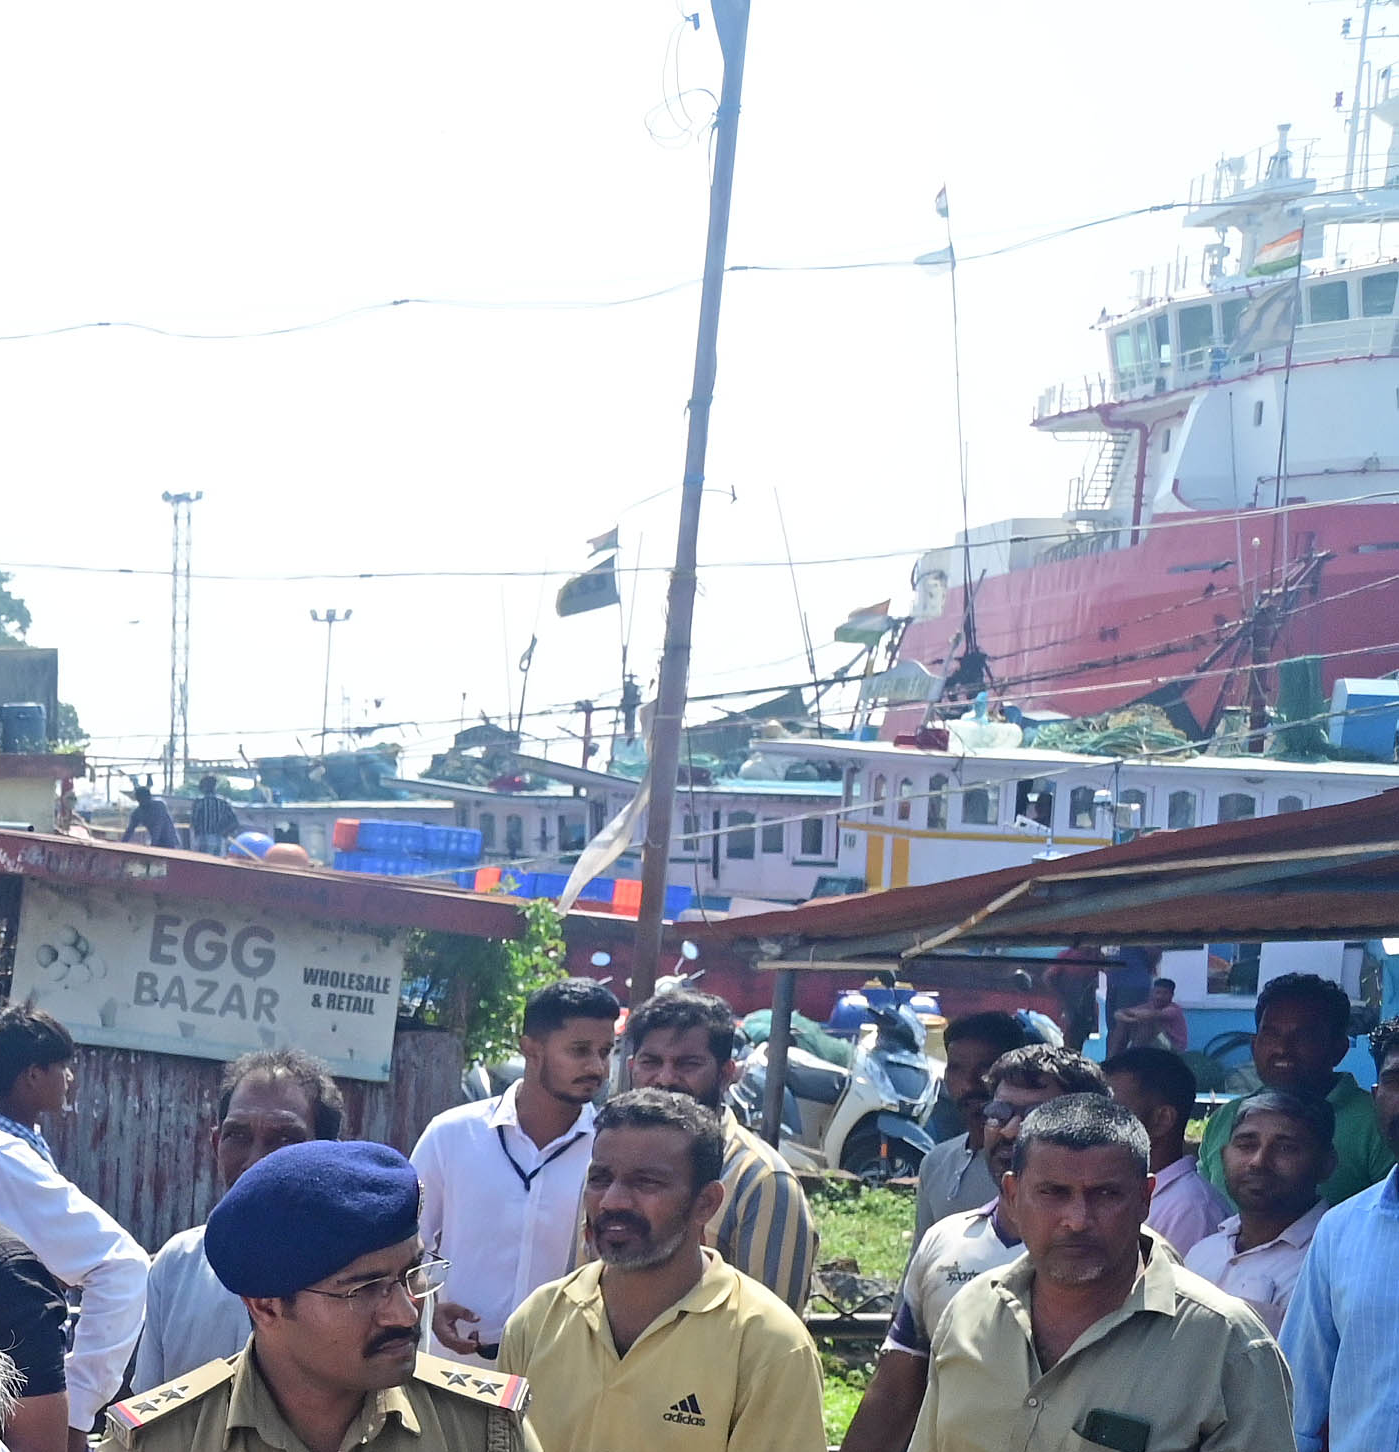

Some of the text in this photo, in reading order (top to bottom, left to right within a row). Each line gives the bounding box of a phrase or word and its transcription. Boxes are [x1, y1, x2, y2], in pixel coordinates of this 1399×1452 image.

[148, 914, 277, 980] EGG
[303, 967, 391, 996] WHOLESALE
[133, 971, 280, 1025] BAZAR
[311, 992, 376, 1016] & RETAIL
[663, 1412, 706, 1427] adidas
